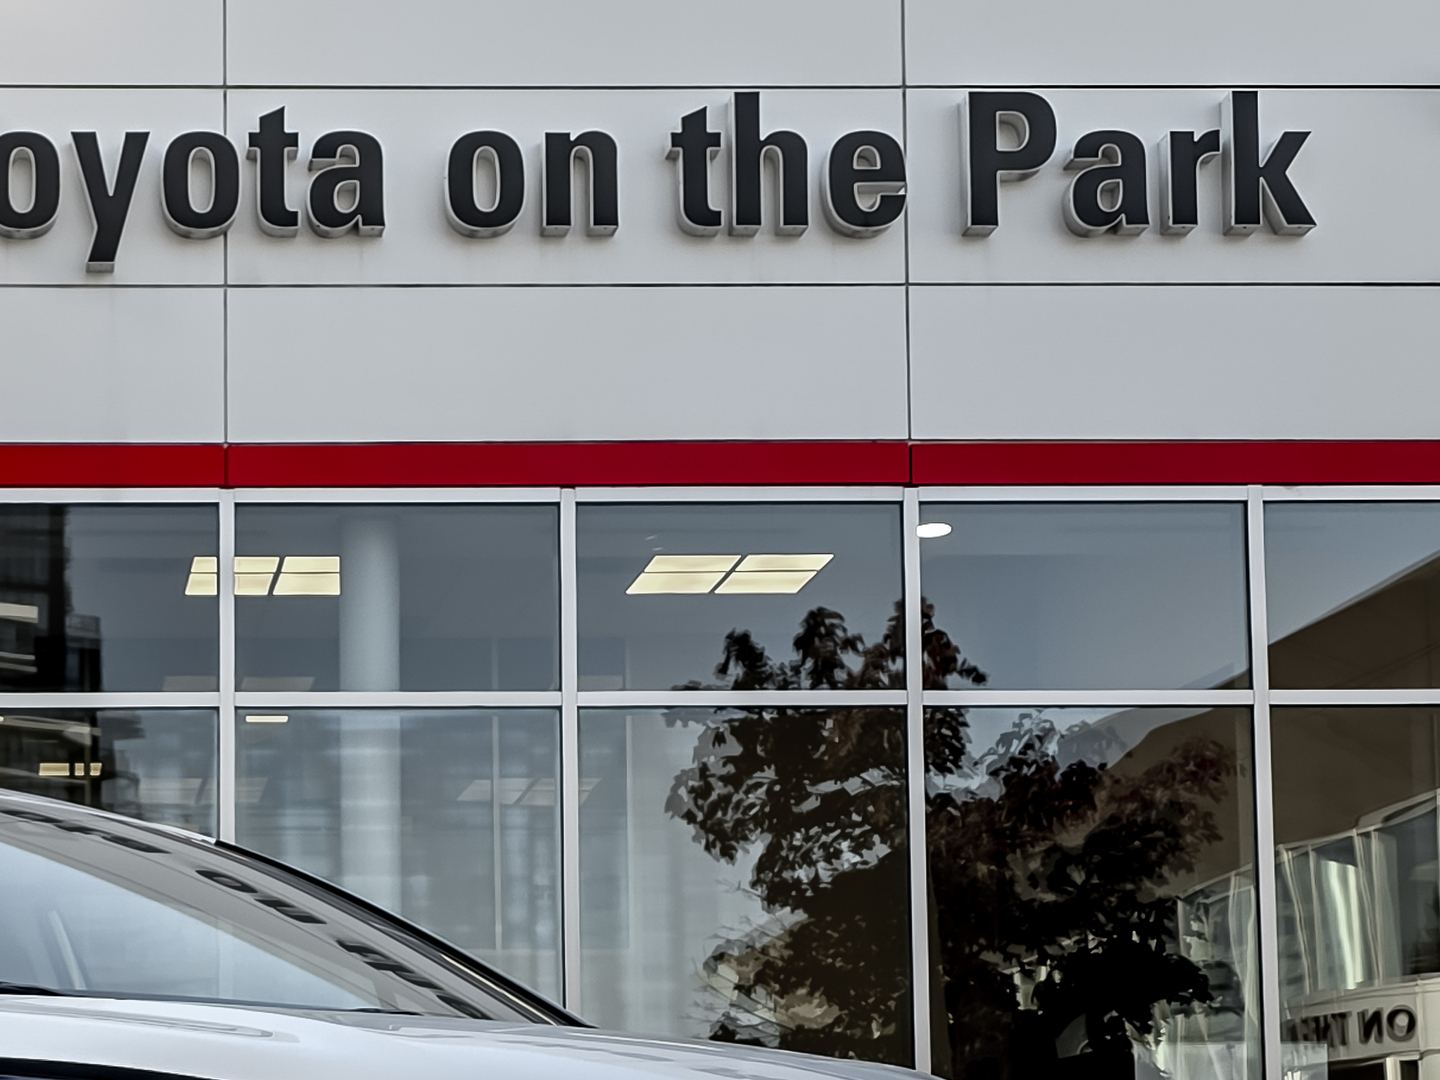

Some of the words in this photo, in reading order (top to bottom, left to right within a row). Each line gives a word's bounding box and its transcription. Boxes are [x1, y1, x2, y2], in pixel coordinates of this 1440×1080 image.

[446, 129, 620, 238] on
[666, 90, 908, 238] the
[962, 89, 1318, 238] Park
